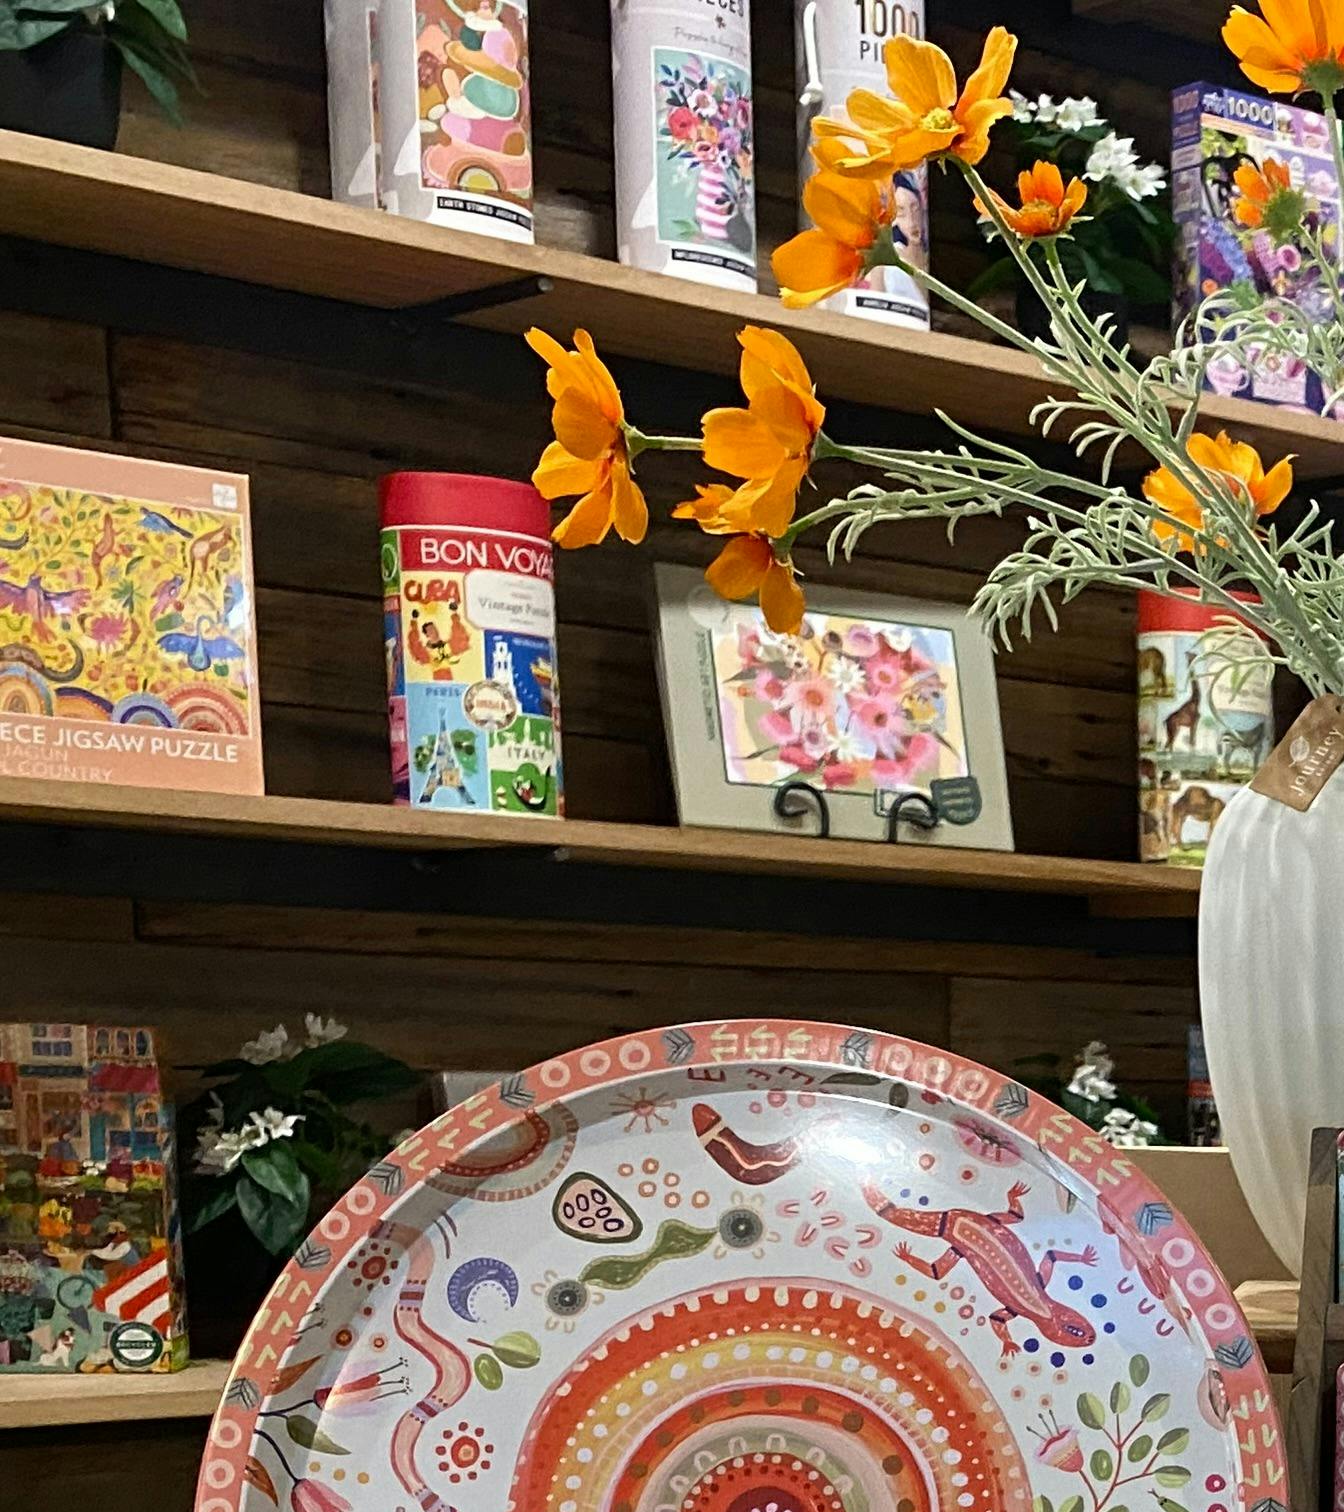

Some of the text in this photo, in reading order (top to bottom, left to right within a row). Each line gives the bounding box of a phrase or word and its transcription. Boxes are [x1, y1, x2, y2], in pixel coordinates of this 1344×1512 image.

[1226, 96, 1273, 125] 1000
[420, 537, 488, 567] BON
[404, 579, 461, 604] CUBA
[52, 729, 145, 752] JIGSAW
[150, 737, 239, 763] PUZZLE
[18, 760, 113, 782] COUNTRY
[1289, 727, 1344, 797] Journey
